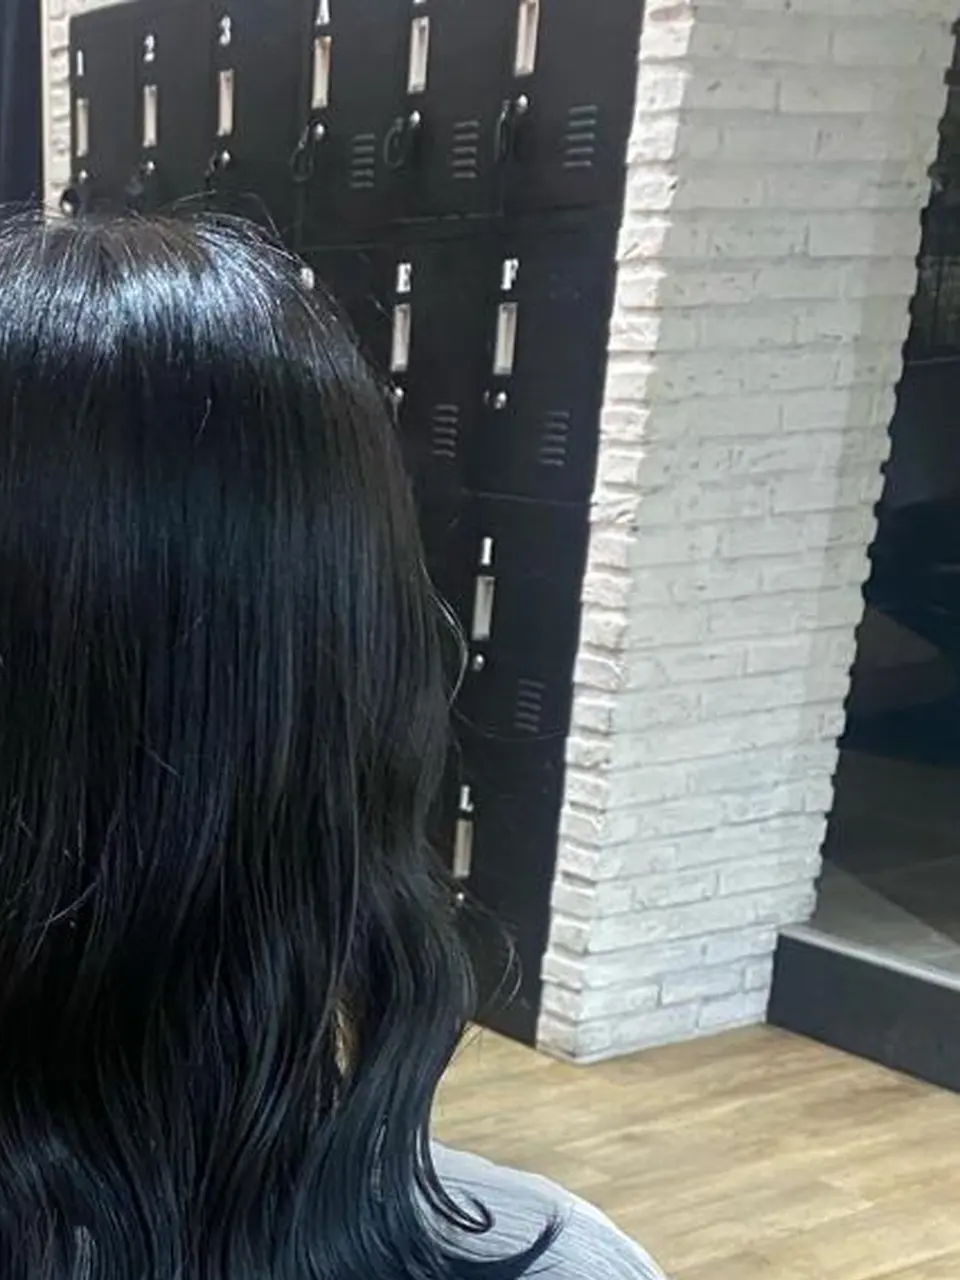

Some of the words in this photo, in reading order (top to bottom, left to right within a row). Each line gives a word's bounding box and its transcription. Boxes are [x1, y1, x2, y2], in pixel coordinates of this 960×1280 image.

[220, 15, 232, 46] 3
[75, 49, 85, 77] 1
[143, 34, 156, 63] 2
[396, 262, 412, 294] E
[500, 258, 519, 291] F
